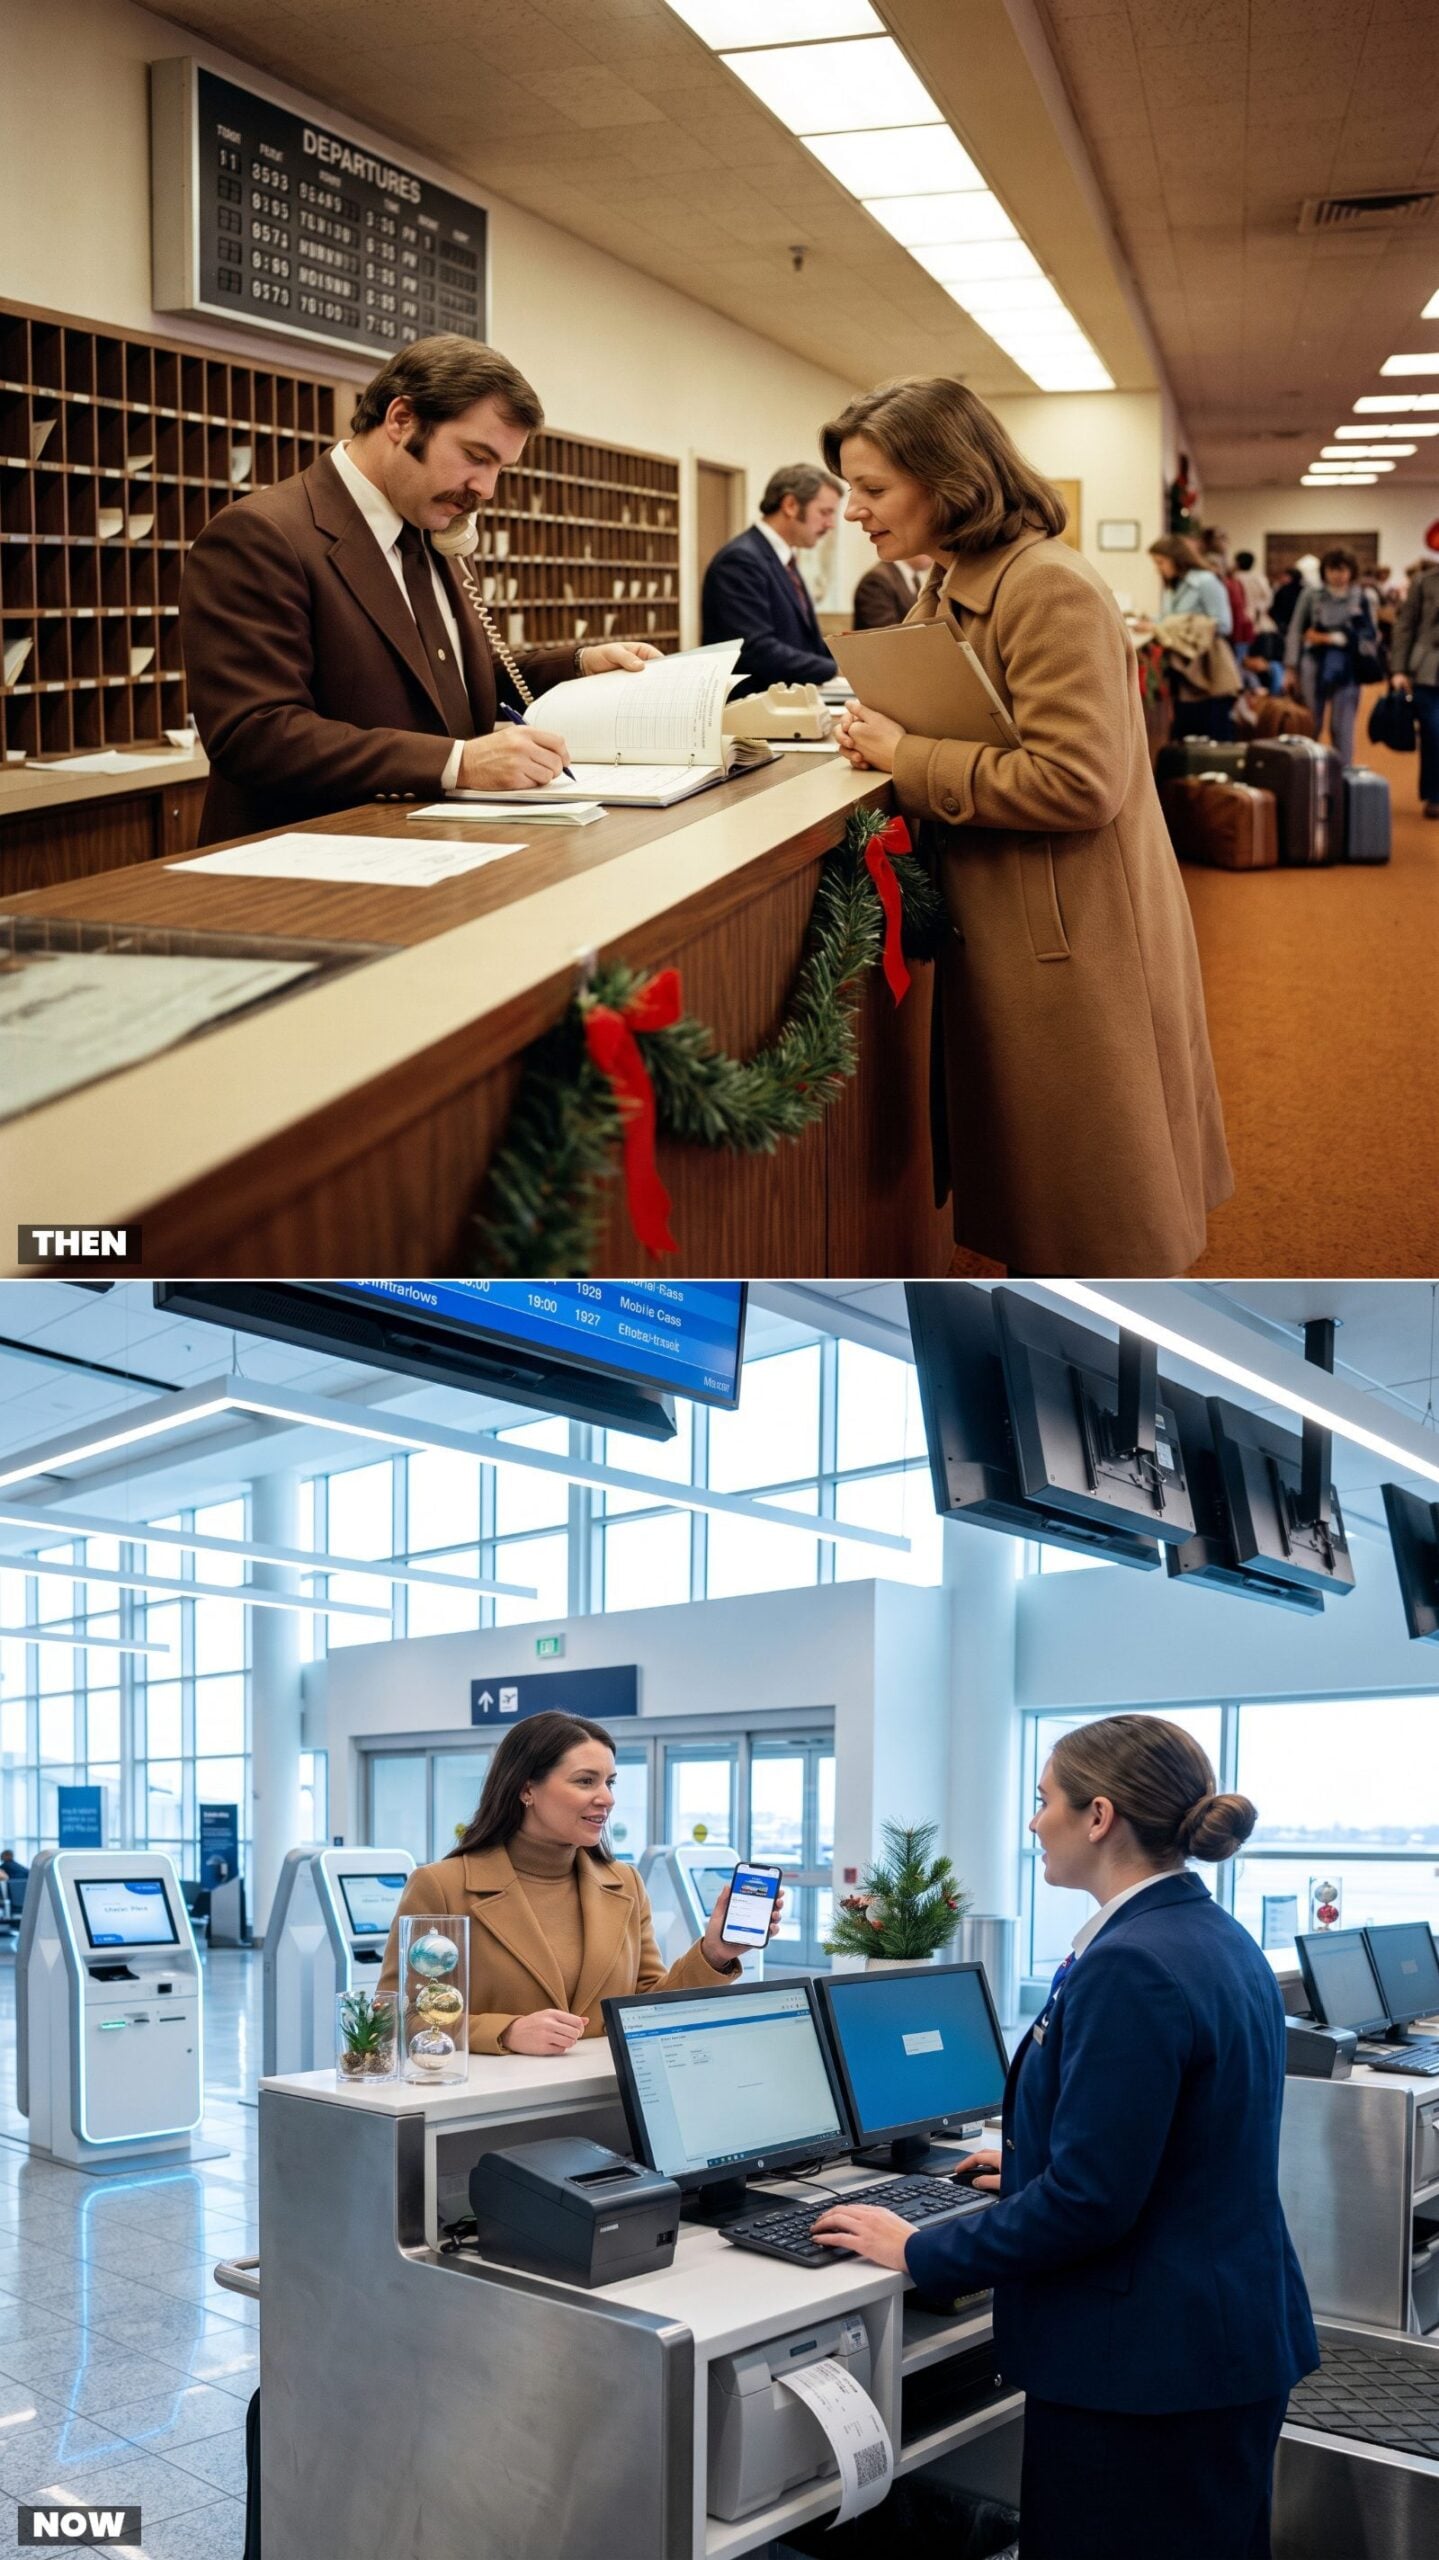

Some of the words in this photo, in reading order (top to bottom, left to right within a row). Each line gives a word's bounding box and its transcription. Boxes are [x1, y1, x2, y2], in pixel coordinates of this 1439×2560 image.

[303, 129, 421, 204] DEPARTURES
[528, 1294, 558, 1313] 19:00
[575, 1309, 601, 1327] 1927
[620, 1296, 655, 1318] Mobile
[657, 1309, 682, 1327] Cass
